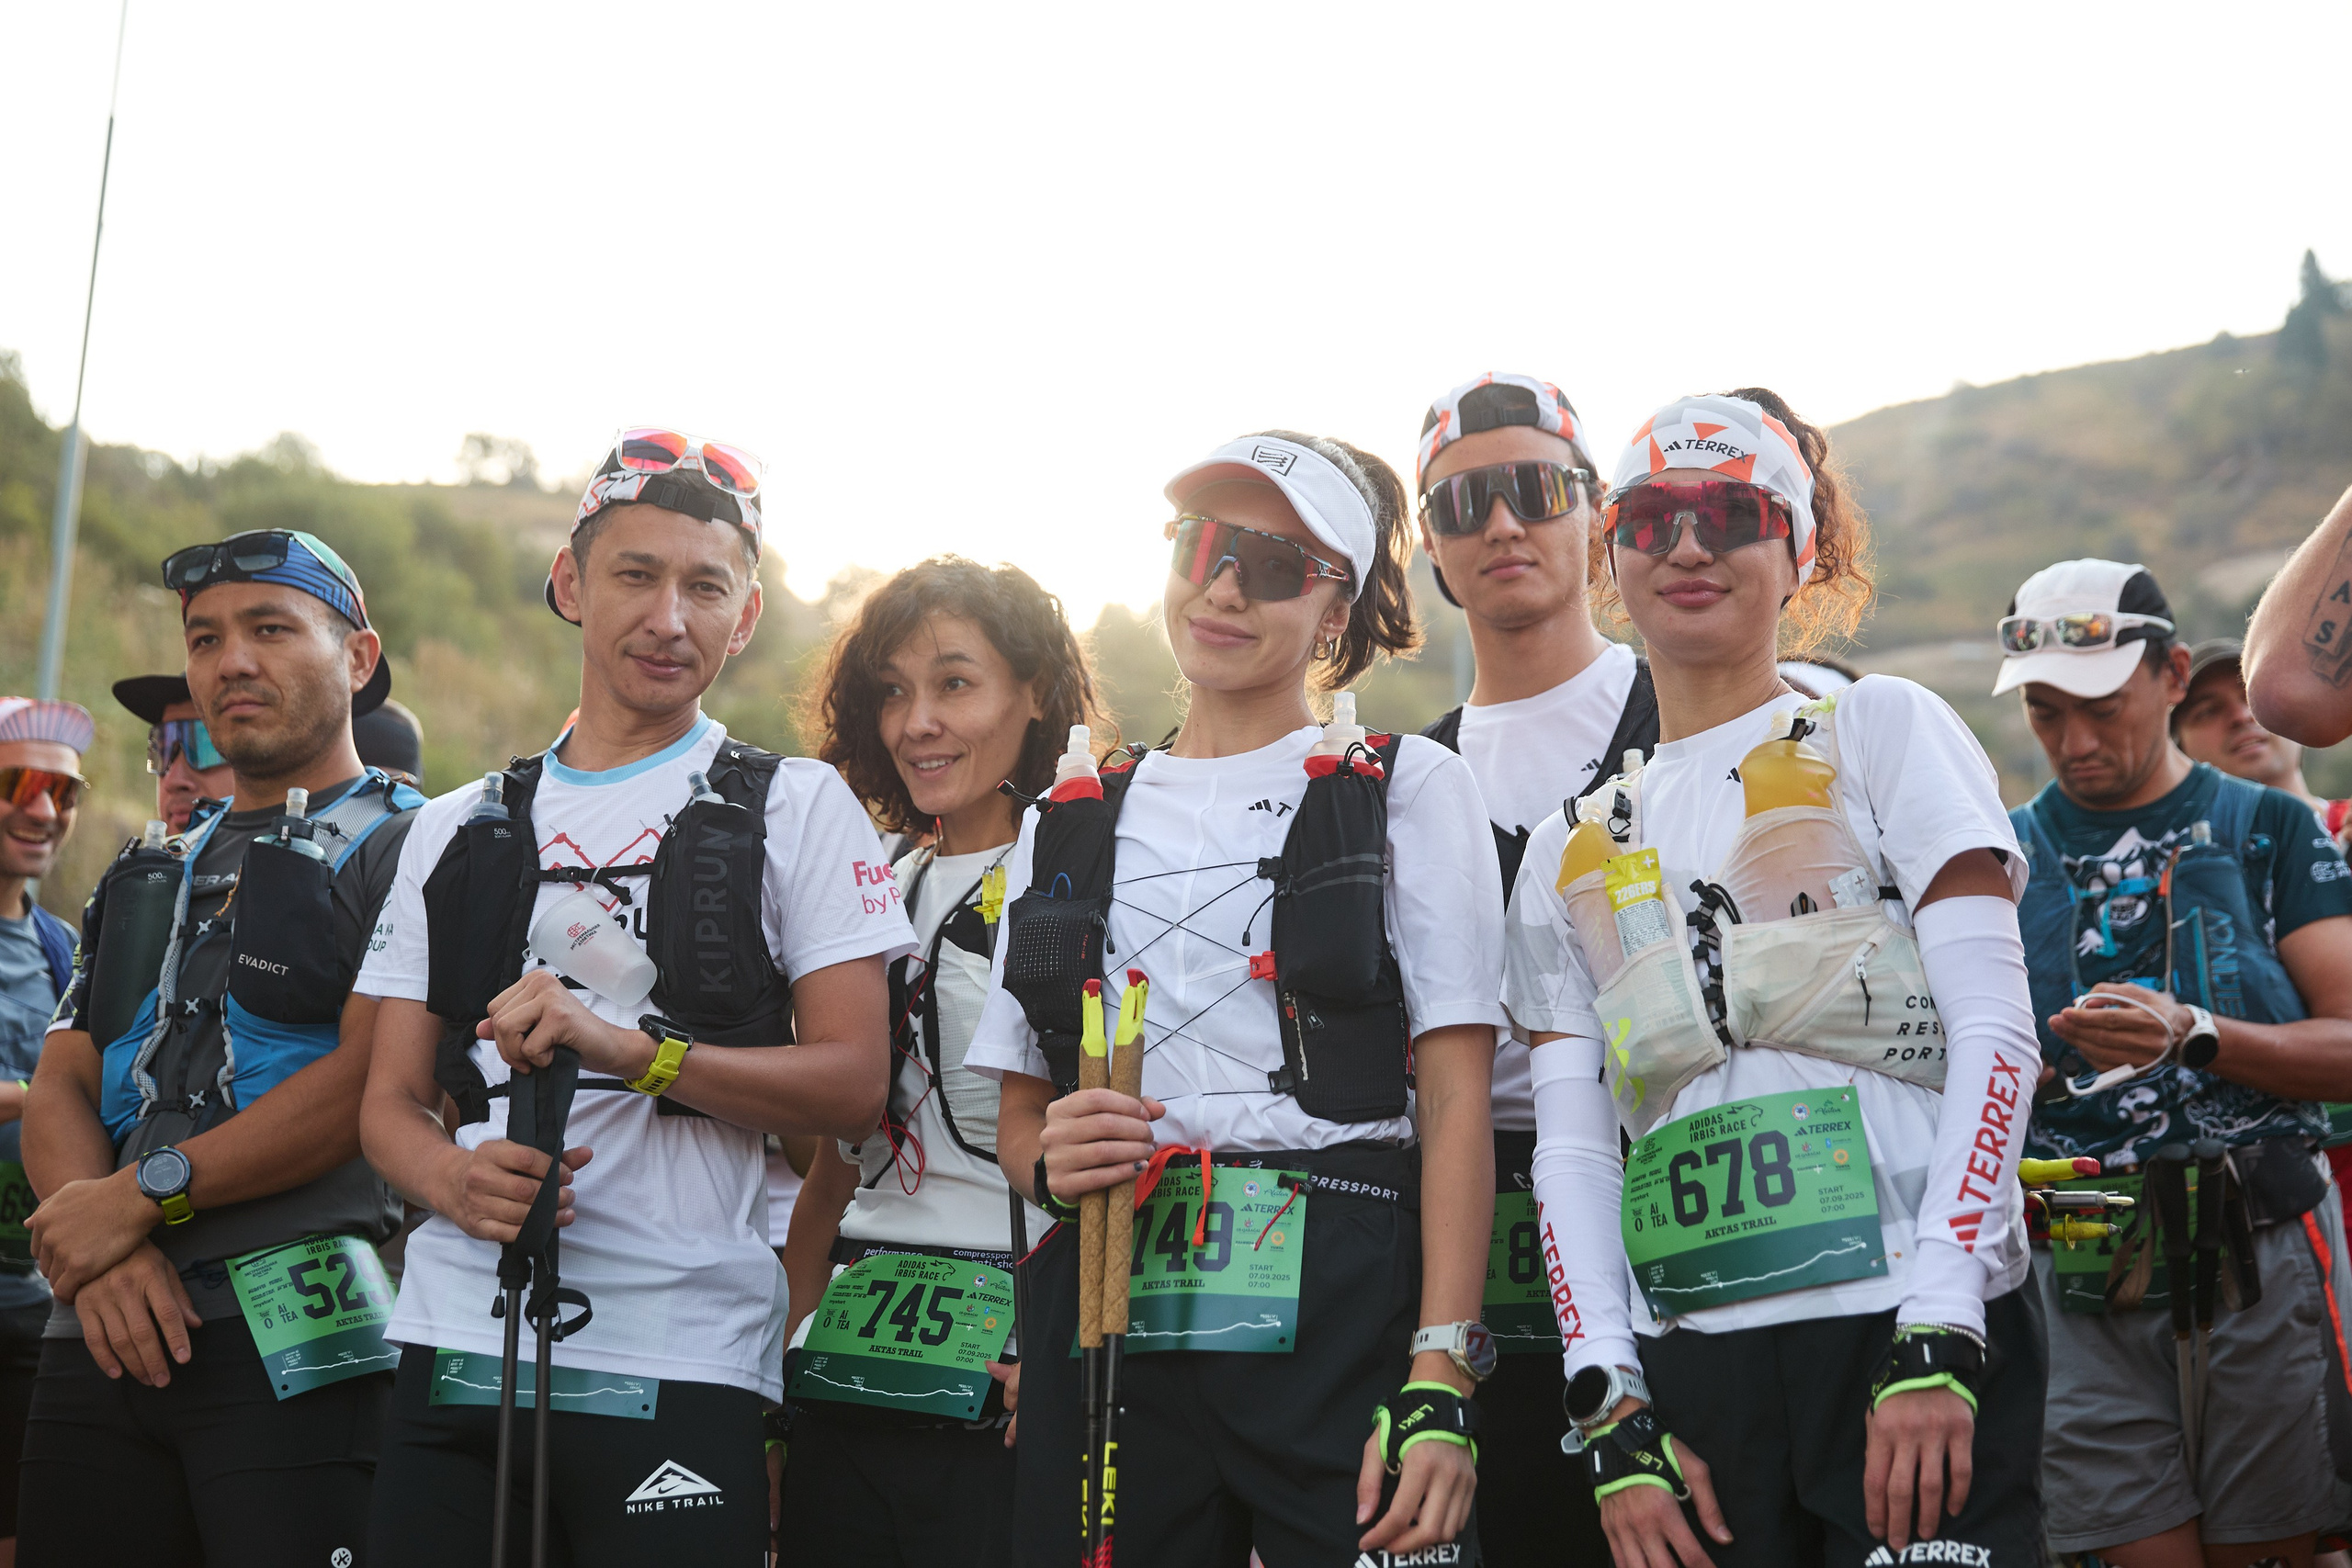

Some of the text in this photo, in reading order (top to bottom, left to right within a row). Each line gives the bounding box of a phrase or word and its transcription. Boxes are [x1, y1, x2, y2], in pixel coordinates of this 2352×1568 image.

[1685, 439, 1748, 463] TERREX
[1614, 881, 1657, 904] 226ERS
[694, 824, 734, 992] KIPRUN
[862, 893, 886, 914] by
[238, 953, 289, 976] EVADICT
[1883, 1046, 1946, 1061] PORT
[1689, 1113, 1724, 1132] ADIDAS
[1808, 1121, 1851, 1134] TERREX
[1957, 1051, 2020, 1203] TERREX
[1690, 1119, 1747, 1143] IRBIS RACE
[1668, 1130, 1796, 1228] 678
[1175, 1186, 1200, 1197] RACE
[1818, 1185, 1844, 1195] START
[1819, 1191, 1865, 1204] 07.09.2025
[1821, 1203, 1846, 1213] 07:00
[1651, 1213, 1668, 1228] TEA
[1705, 1216, 1776, 1239] AKTAS TRAIL
[1130, 1201, 1235, 1277] 749
[306, 1242, 331, 1256] IRBIS
[898, 1259, 927, 1269] ADIDAS
[894, 1269, 940, 1280] IRBIS RACE
[1249, 1273, 1291, 1281] 07.09.2025
[287, 1249, 392, 1320] 529
[1142, 1278, 1204, 1291] AKTAS TRAIL
[1540, 1222, 1585, 1351] TERREX
[978, 1292, 1012, 1307] TERREX
[280, 1311, 299, 1324] TEA
[335, 1311, 386, 1327] AKTAS TRAIL
[857, 1280, 965, 1347] 745
[837, 1320, 850, 1330] TEA
[868, 1344, 923, 1359] AKTAS TRAIL
[958, 1348, 991, 1359] 07.09.2025
[960, 1341, 980, 1350] START
[956, 1356, 974, 1364] 07:00
[1398, 1404, 1433, 1430] LEKI
[1101, 1441, 1118, 1526] LEKI
[627, 1495, 724, 1514] NIKE TRAIL
[1378, 1543, 1461, 1568] TERREX
[1897, 1540, 1991, 1568] TERREX
